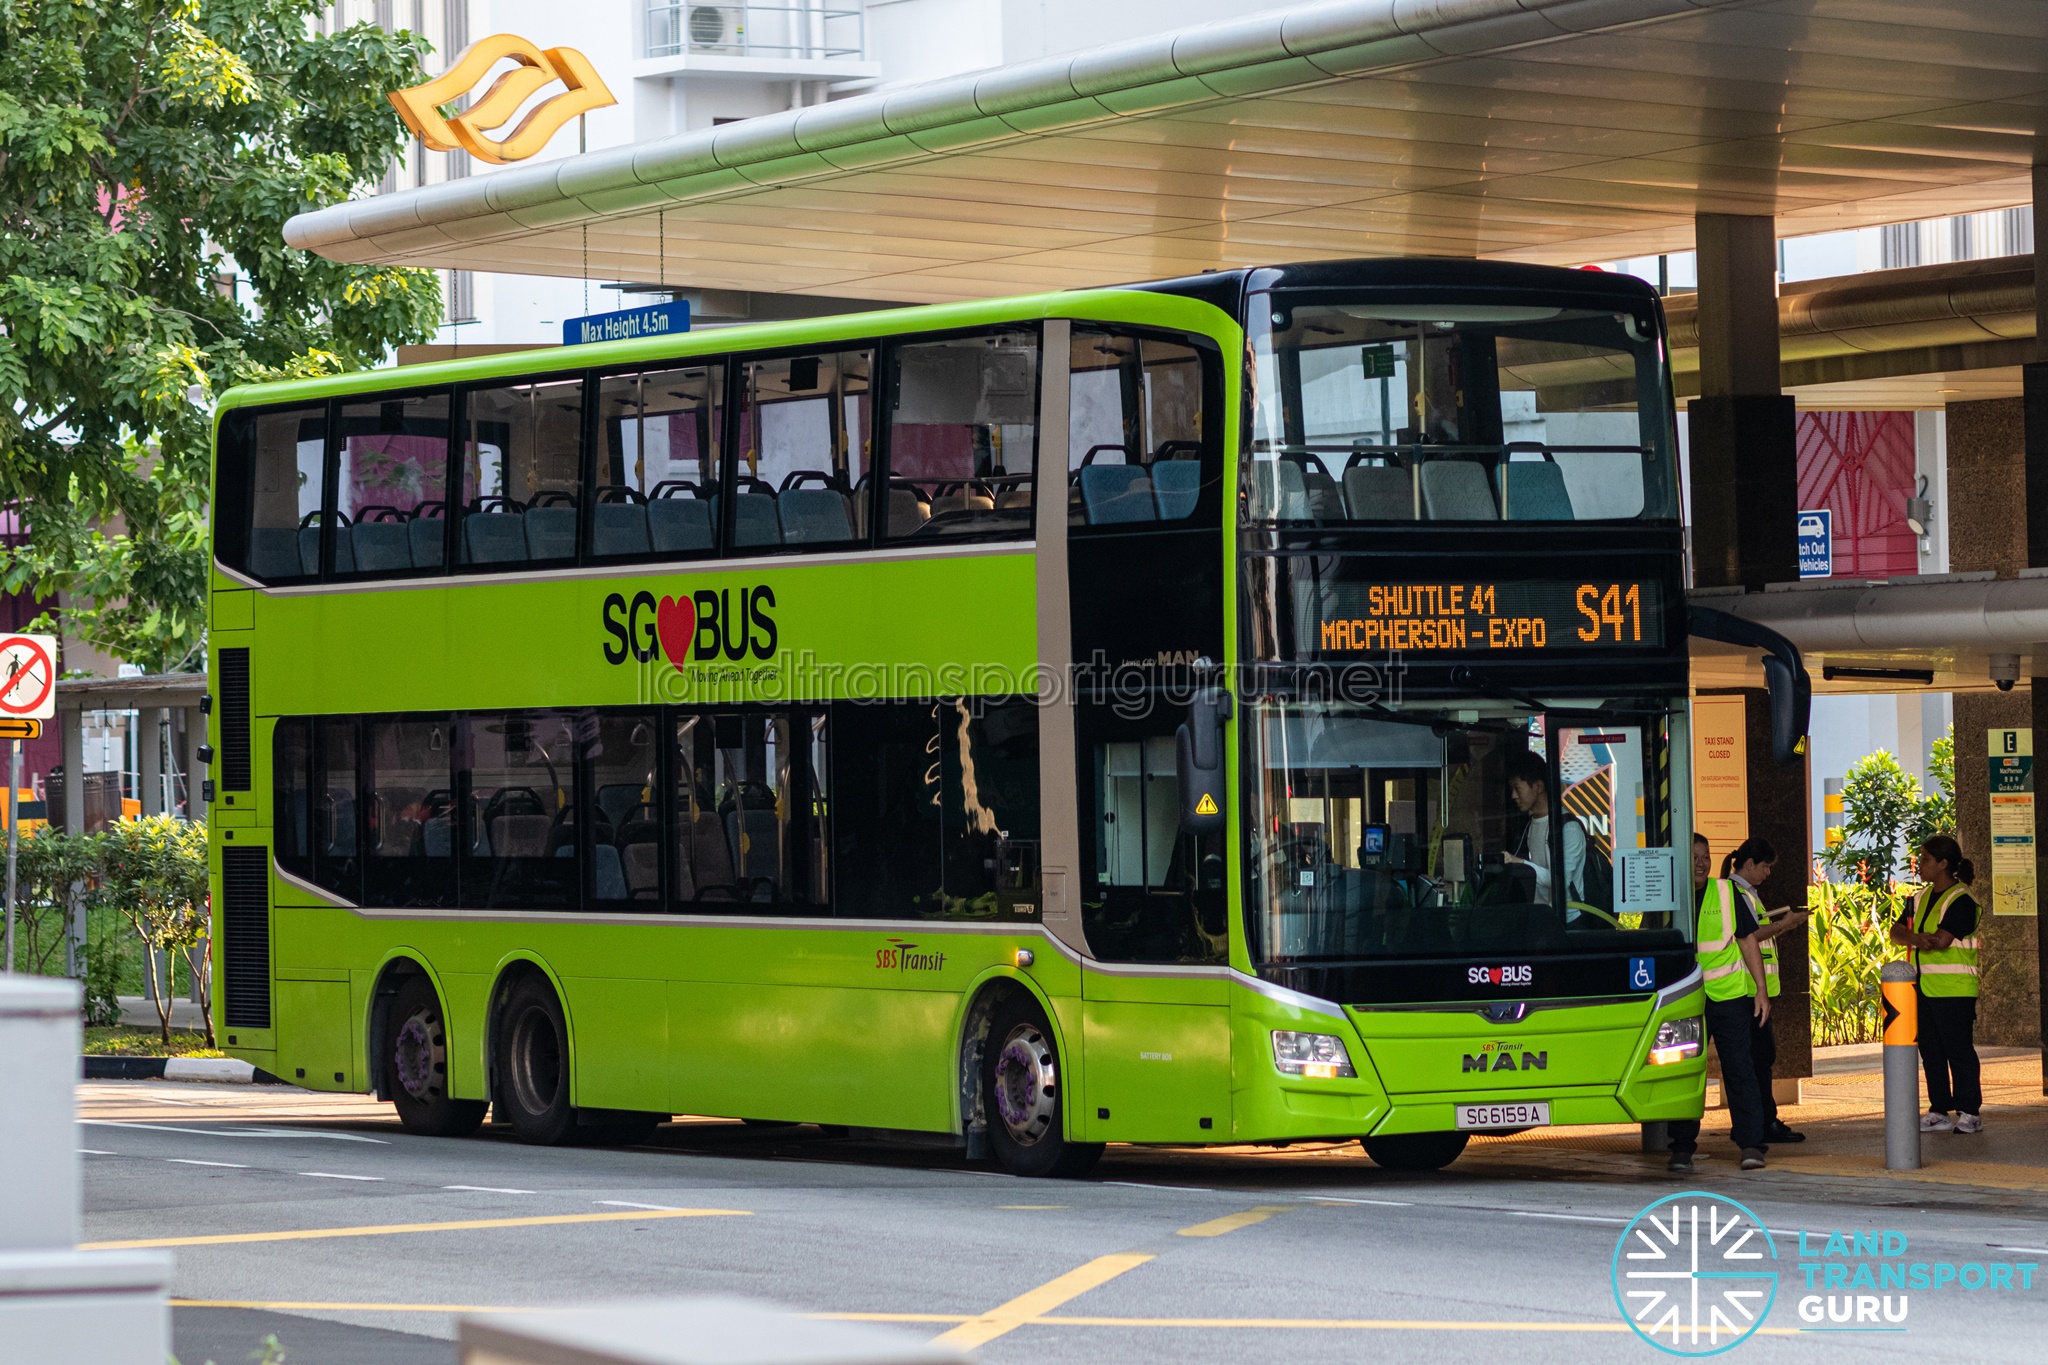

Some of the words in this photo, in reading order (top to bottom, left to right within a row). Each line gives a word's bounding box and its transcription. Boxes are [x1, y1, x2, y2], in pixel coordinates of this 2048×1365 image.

[581, 321, 603, 343] Max
[605, 314, 640, 340] Height
[642, 311, 669, 333] 4.5m
[1799, 542, 1810, 555] tch
[1811, 541, 1826, 555] Out
[1799, 557, 1829, 572] Vehicles
[1368, 585, 1465, 616] SHUTTLE
[1470, 585, 1496, 615] 41
[1576, 584, 1641, 642] S41
[1321, 618, 1466, 650] MACPHERSON
[1488, 618, 1547, 648] EXPO
[1157, 649, 1199, 666] MAN
[691, 669, 719, 686] Moving
[720, 668, 744, 681] Ahead
[745, 667, 778, 685] Together
[1704, 737, 1716, 746] TAXI
[1716, 736, 1735, 746] STAND
[2006, 733, 2014, 751] E
[1708, 750, 1731, 759] CLOSED
[875, 949, 897, 969] SBS
[894, 944, 948, 973] Transit
[1481, 1043, 1495, 1052] SBS
[1494, 1041, 1524, 1052] Transit
[1140, 1051, 1161, 1060] BATTERY
[1161, 1052, 1172, 1061] BOX
[1462, 1051, 1548, 1073] MAN
